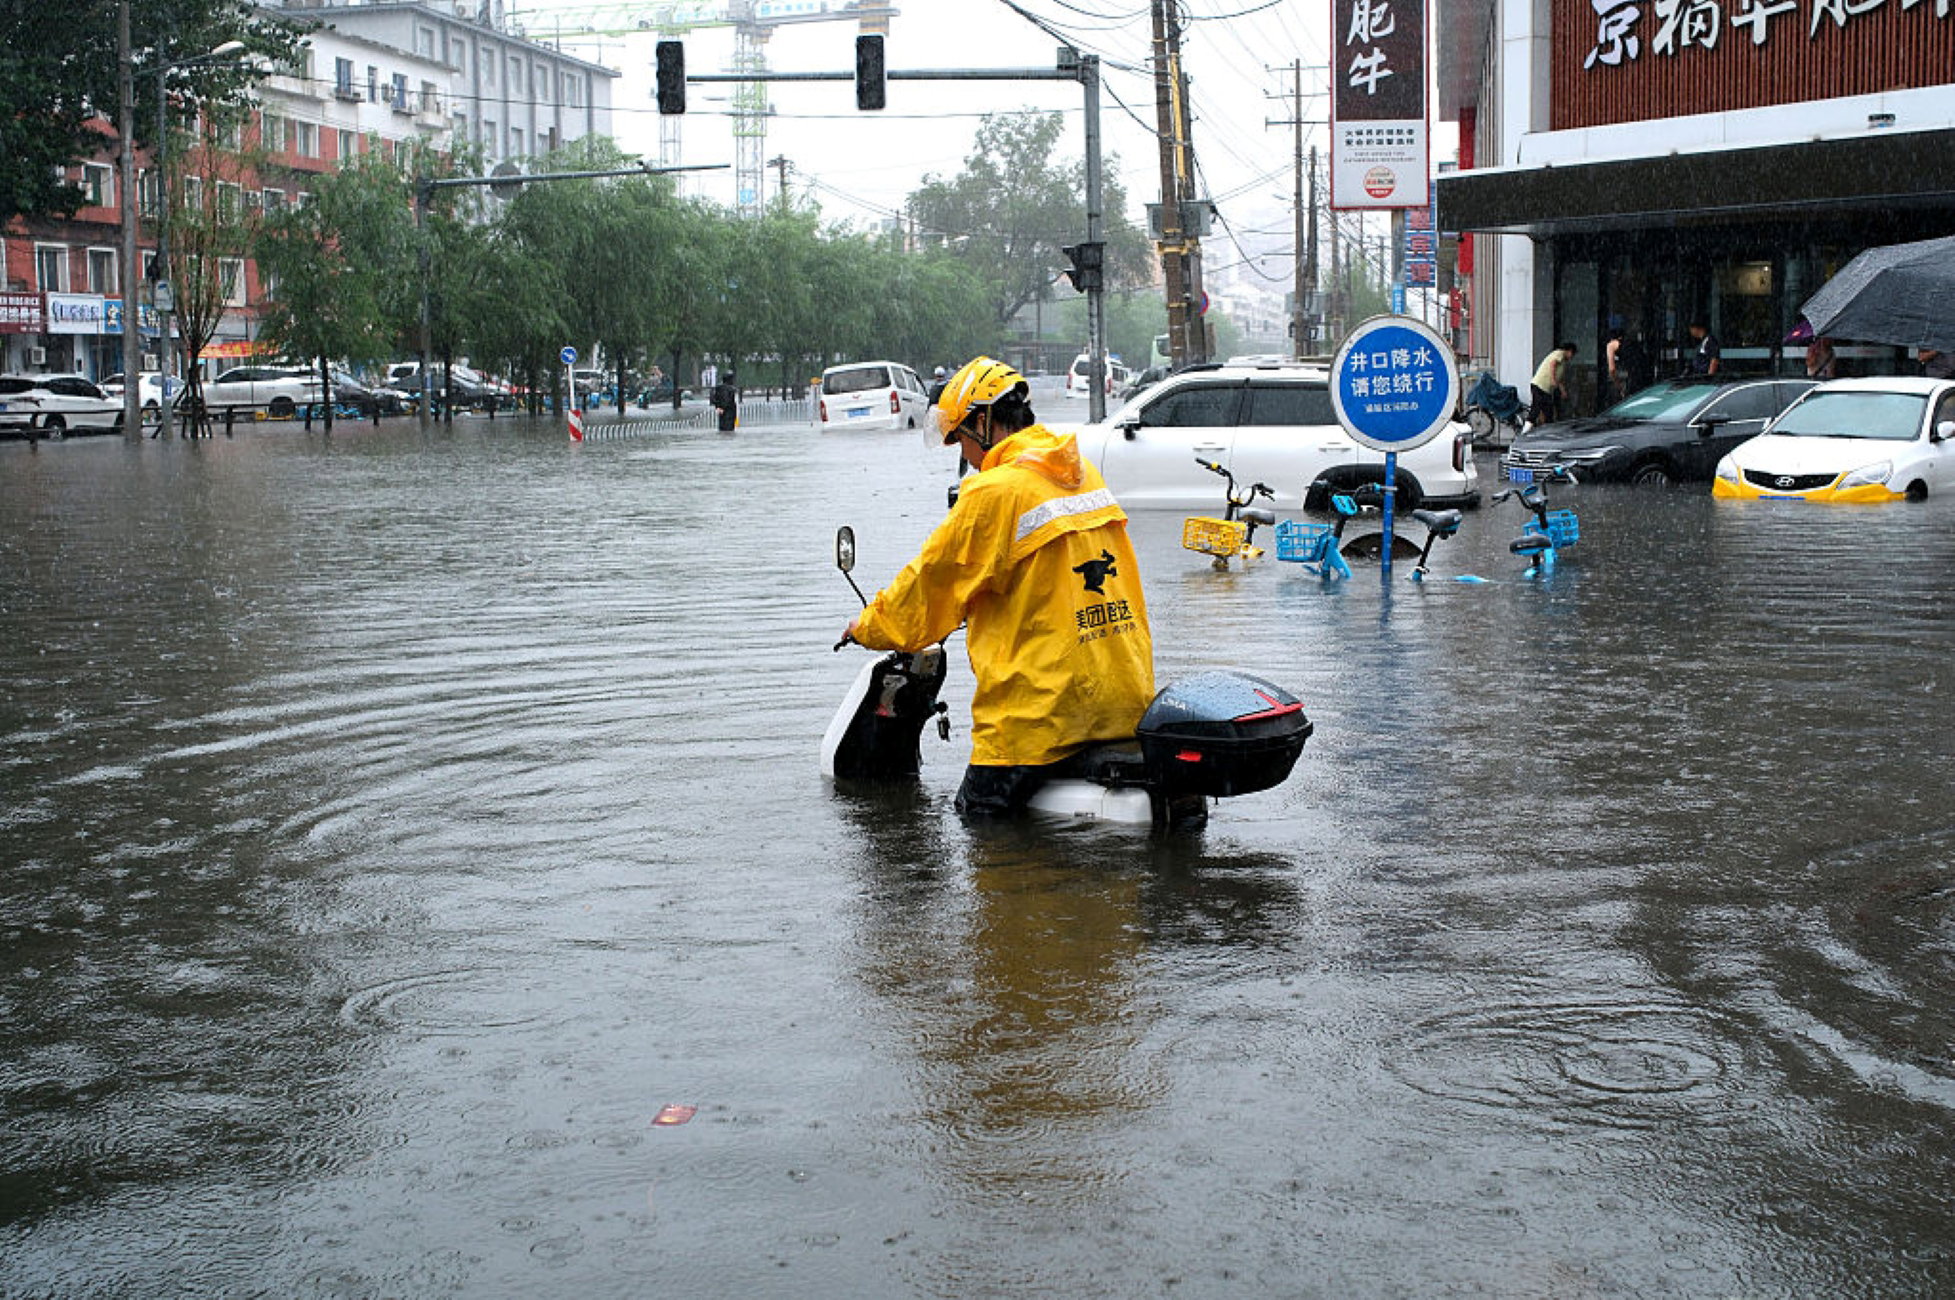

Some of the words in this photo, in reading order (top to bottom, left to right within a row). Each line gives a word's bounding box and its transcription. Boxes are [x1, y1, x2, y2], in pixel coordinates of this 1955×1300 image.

[1346, 0, 1395, 95] 肥牛
[1350, 346, 1433, 372] 井口降水
[1351, 371, 1434, 397] 请您绕行
